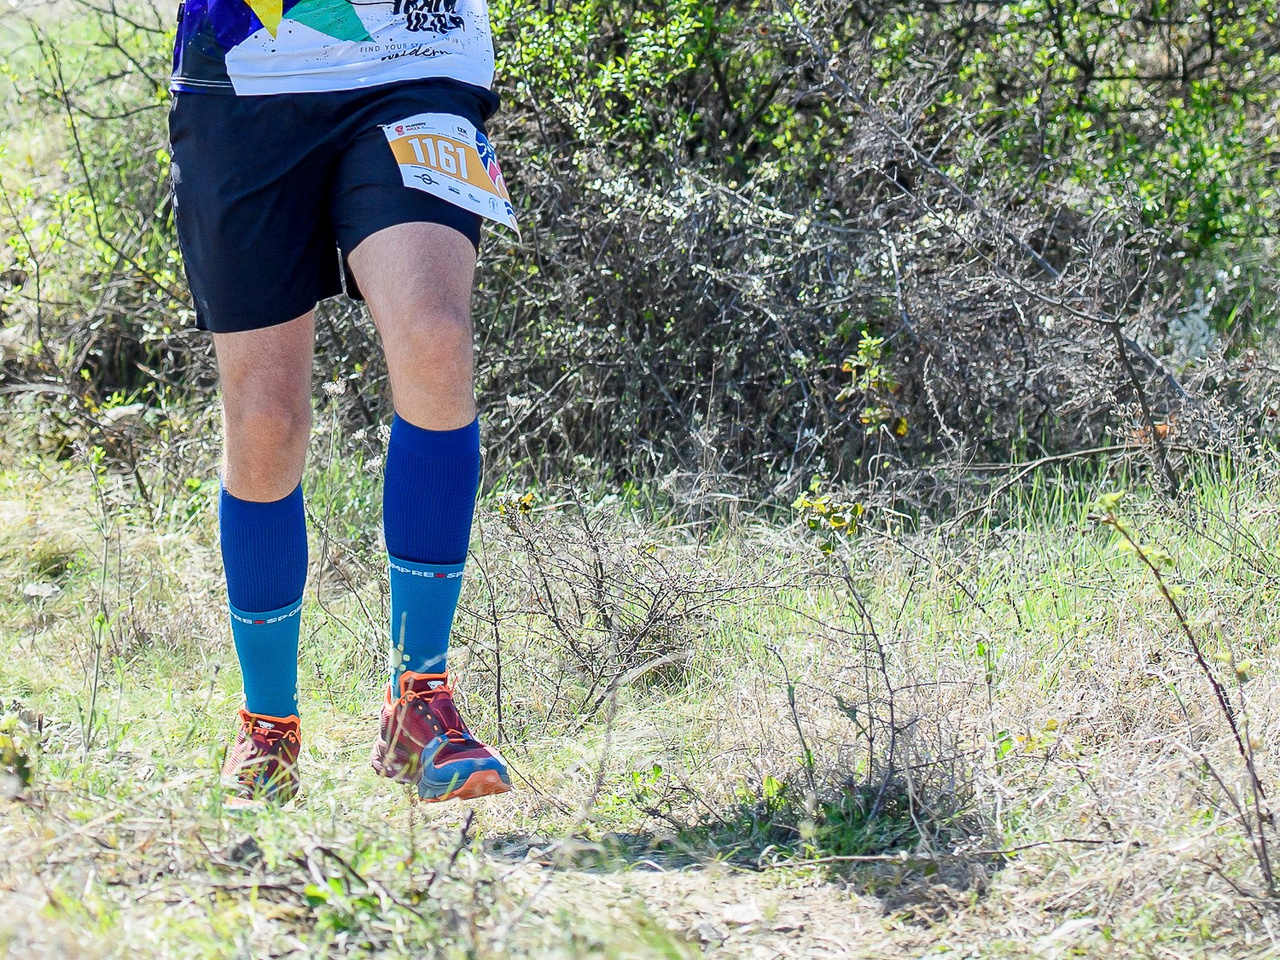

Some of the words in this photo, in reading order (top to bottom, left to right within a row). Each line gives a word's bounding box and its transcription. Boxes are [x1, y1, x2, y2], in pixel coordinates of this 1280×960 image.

[360, 45, 381, 53] FIND
[385, 43, 407, 51] YOUR
[407, 137, 469, 180] 1161
